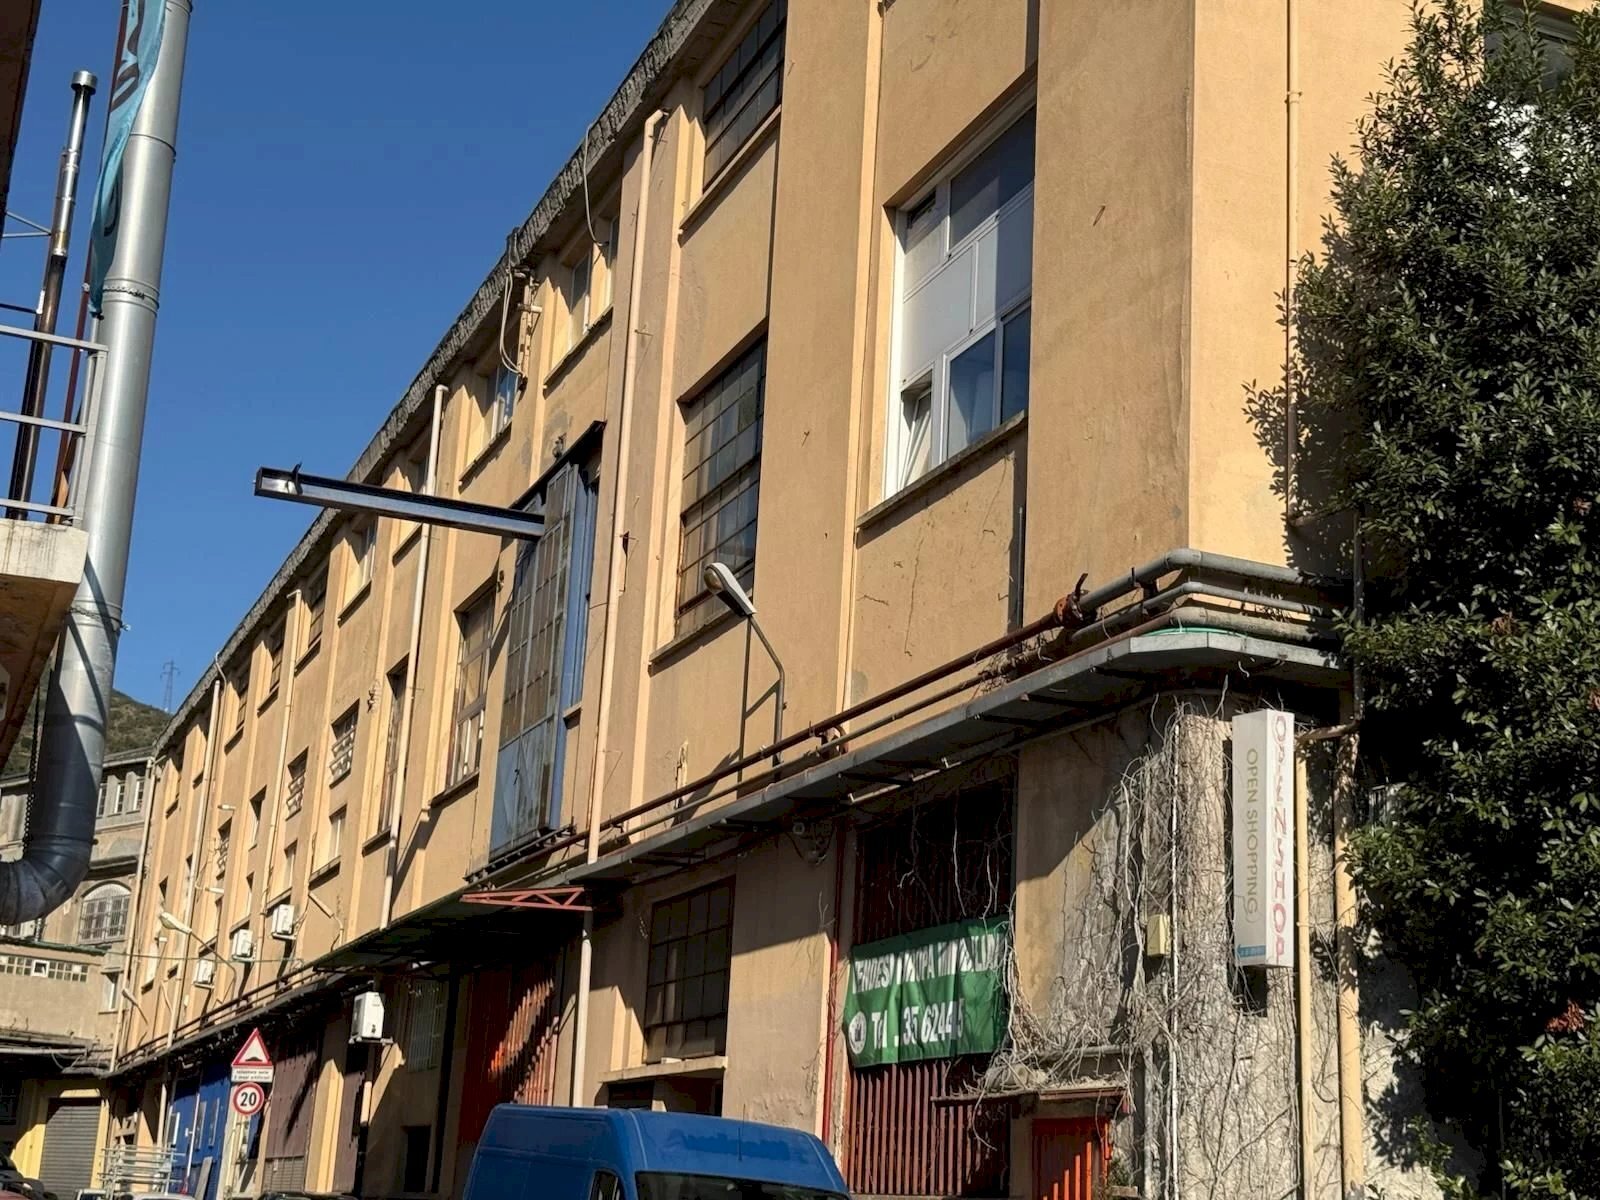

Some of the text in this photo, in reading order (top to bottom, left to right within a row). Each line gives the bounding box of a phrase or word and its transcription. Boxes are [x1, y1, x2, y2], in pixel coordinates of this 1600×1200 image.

[1246, 748, 1259, 915] OPEN SHOPPING
[240, 1091, 257, 1107] 20
